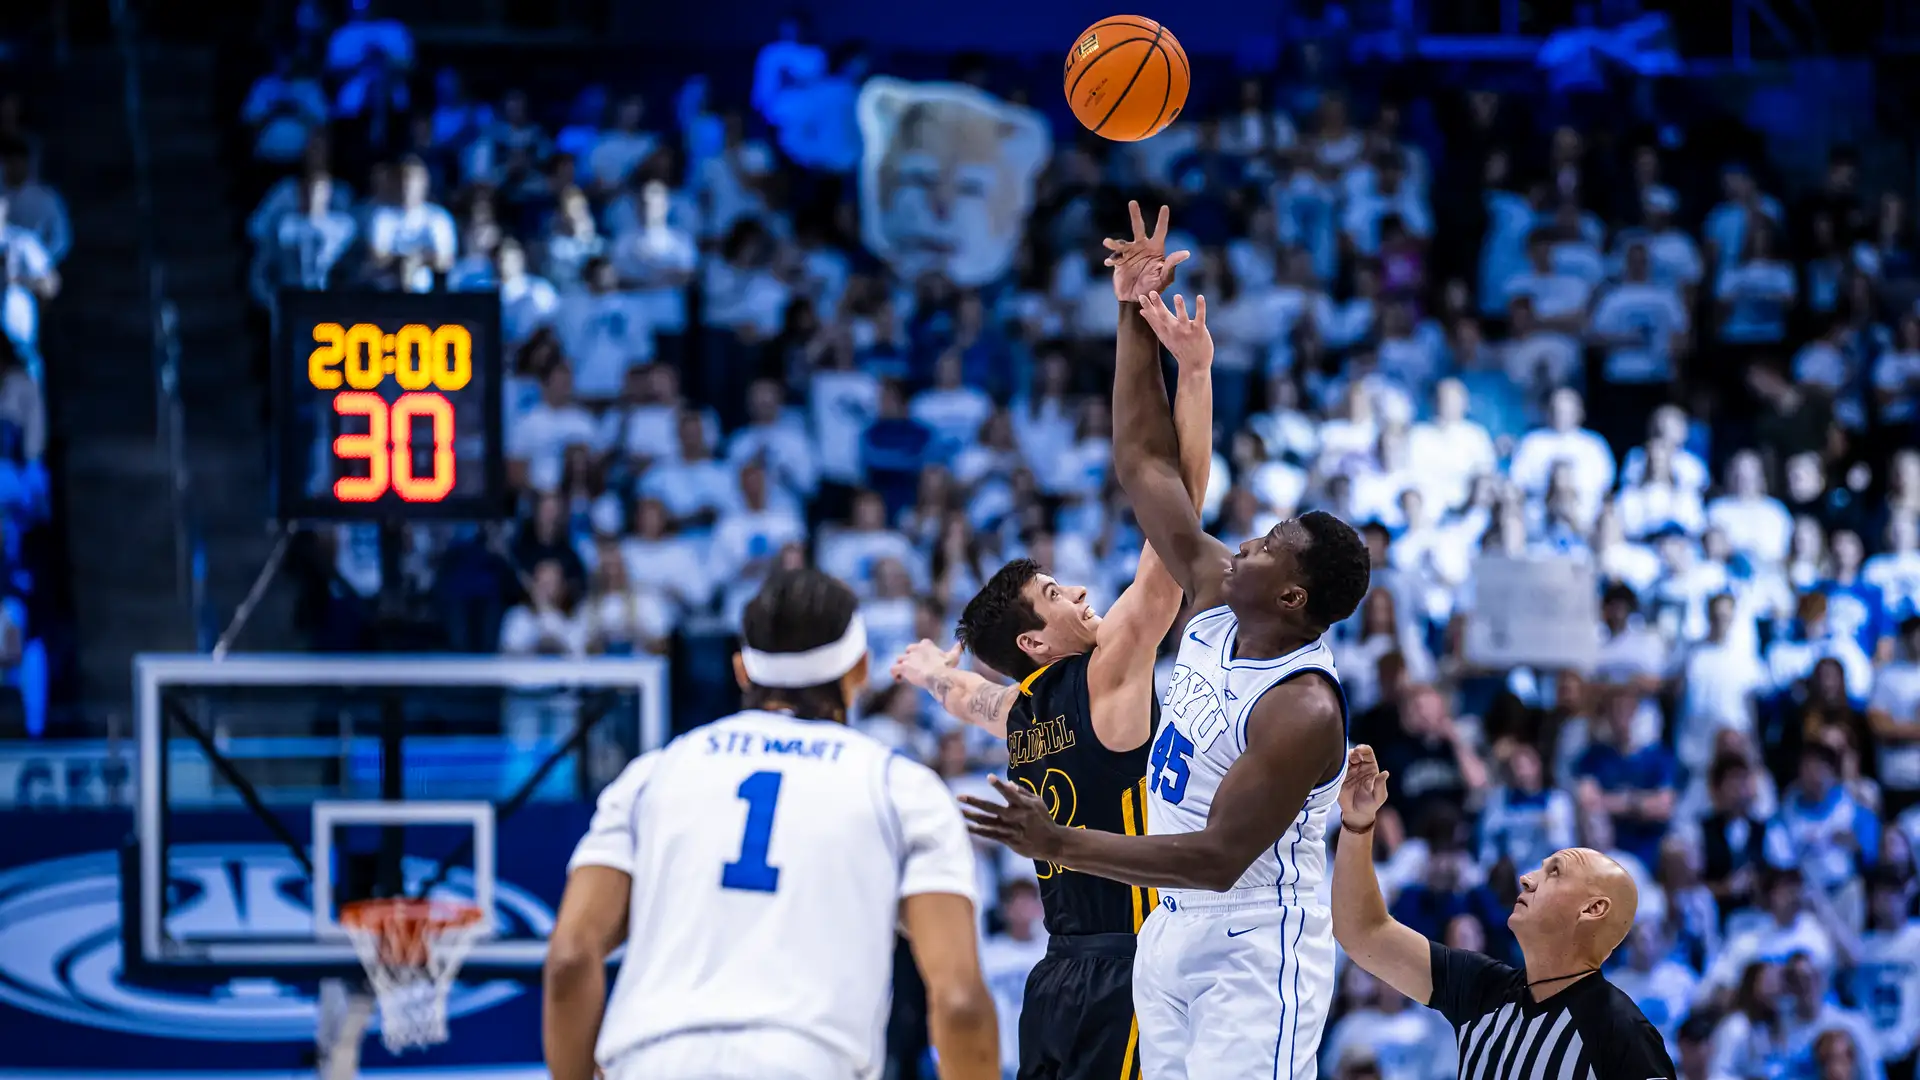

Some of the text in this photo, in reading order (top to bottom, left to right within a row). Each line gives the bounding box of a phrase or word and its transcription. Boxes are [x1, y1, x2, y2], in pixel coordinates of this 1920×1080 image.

[308, 322, 472, 390] 20:00
[333, 391, 456, 503] 30
[705, 731, 846, 764] STEWART
[1163, 664, 1230, 754] BYU
[1150, 721, 1195, 806] 45
[722, 771, 782, 893] 1
